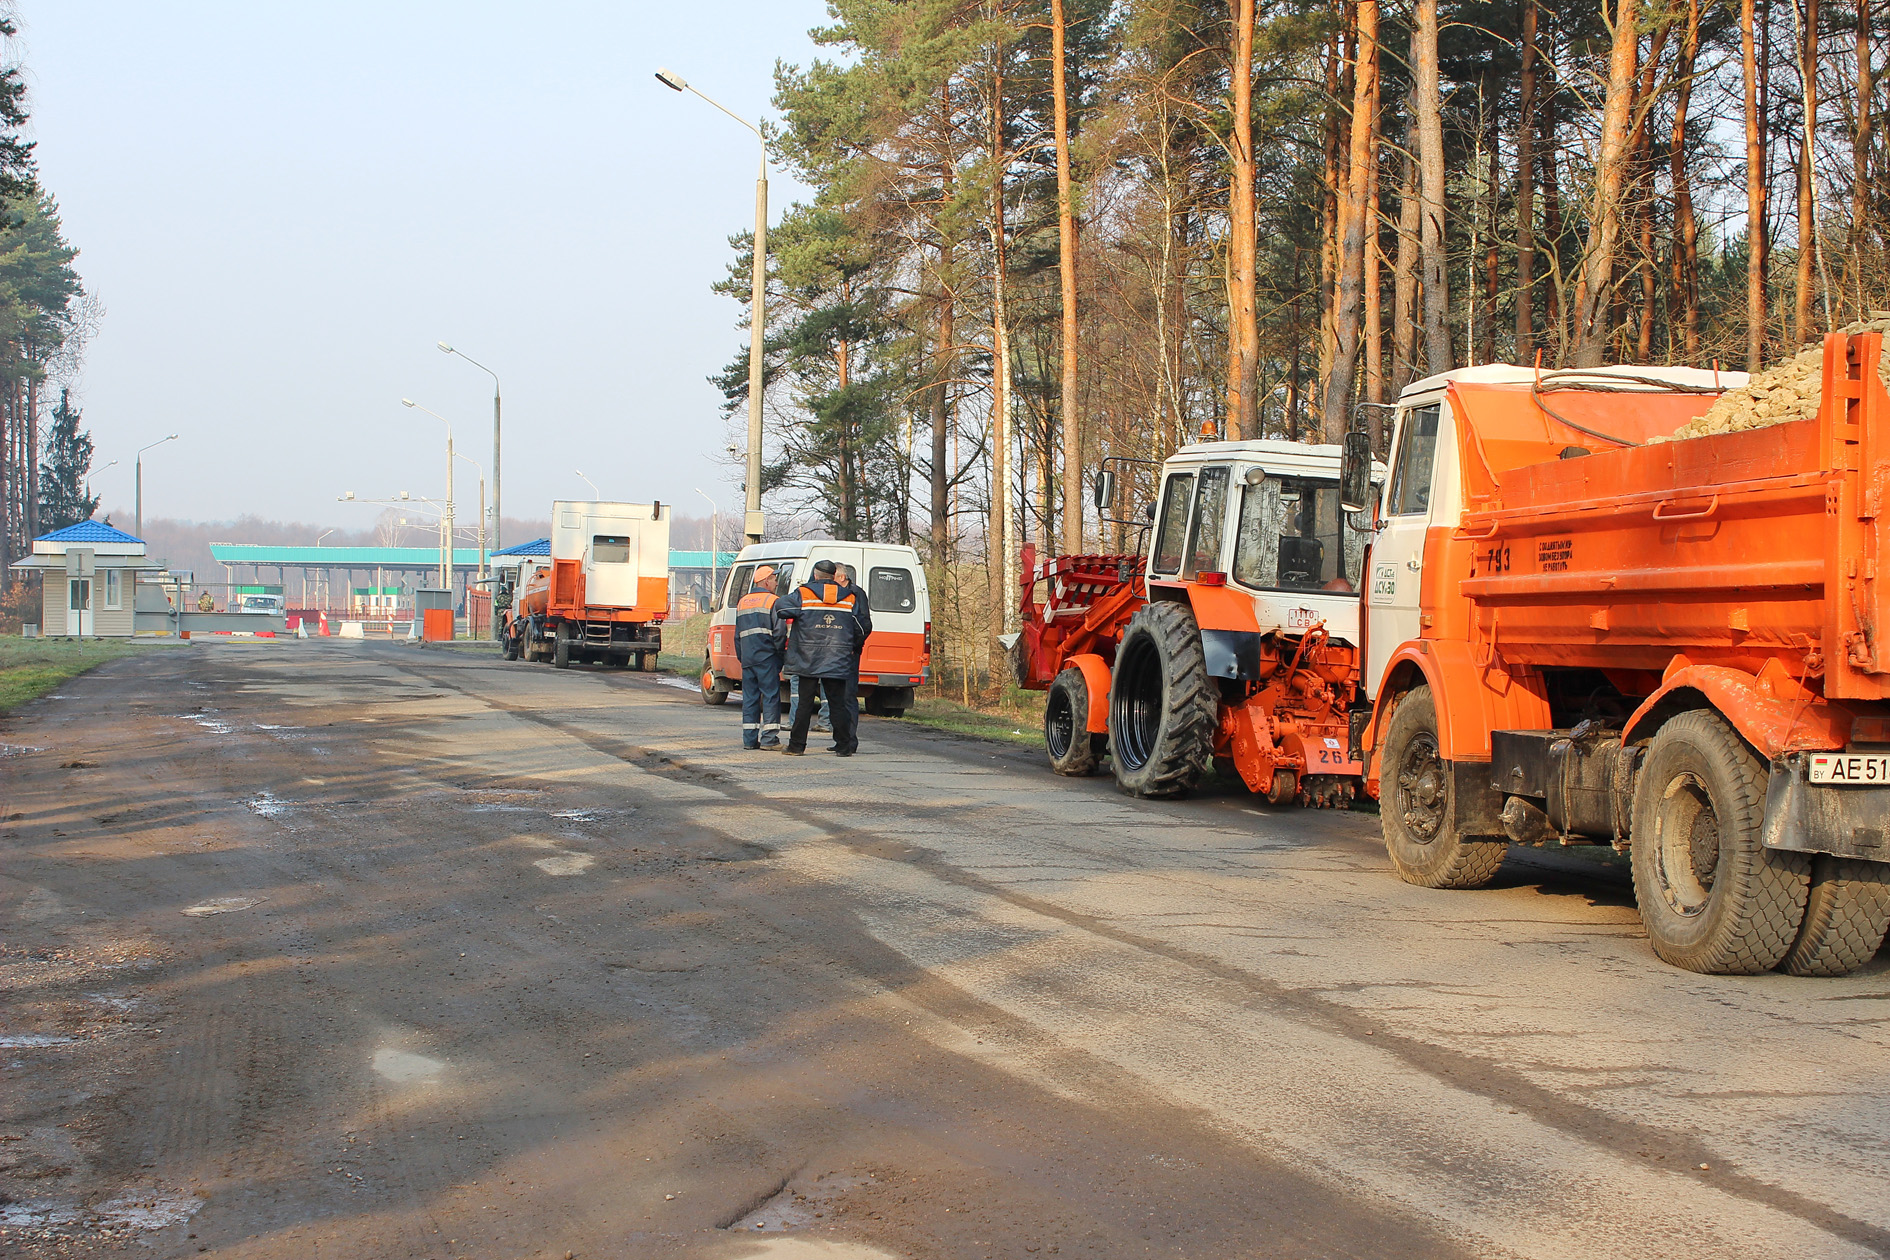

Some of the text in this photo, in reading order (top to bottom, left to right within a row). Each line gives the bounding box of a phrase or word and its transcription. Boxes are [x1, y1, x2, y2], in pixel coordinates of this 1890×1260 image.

[1488, 547, 1510, 572] 793
[1294, 610, 1314, 619] 1110
[1319, 750, 1351, 764] 26
[1813, 770, 1825, 779] BY
[1865, 758, 1890, 780] 51
